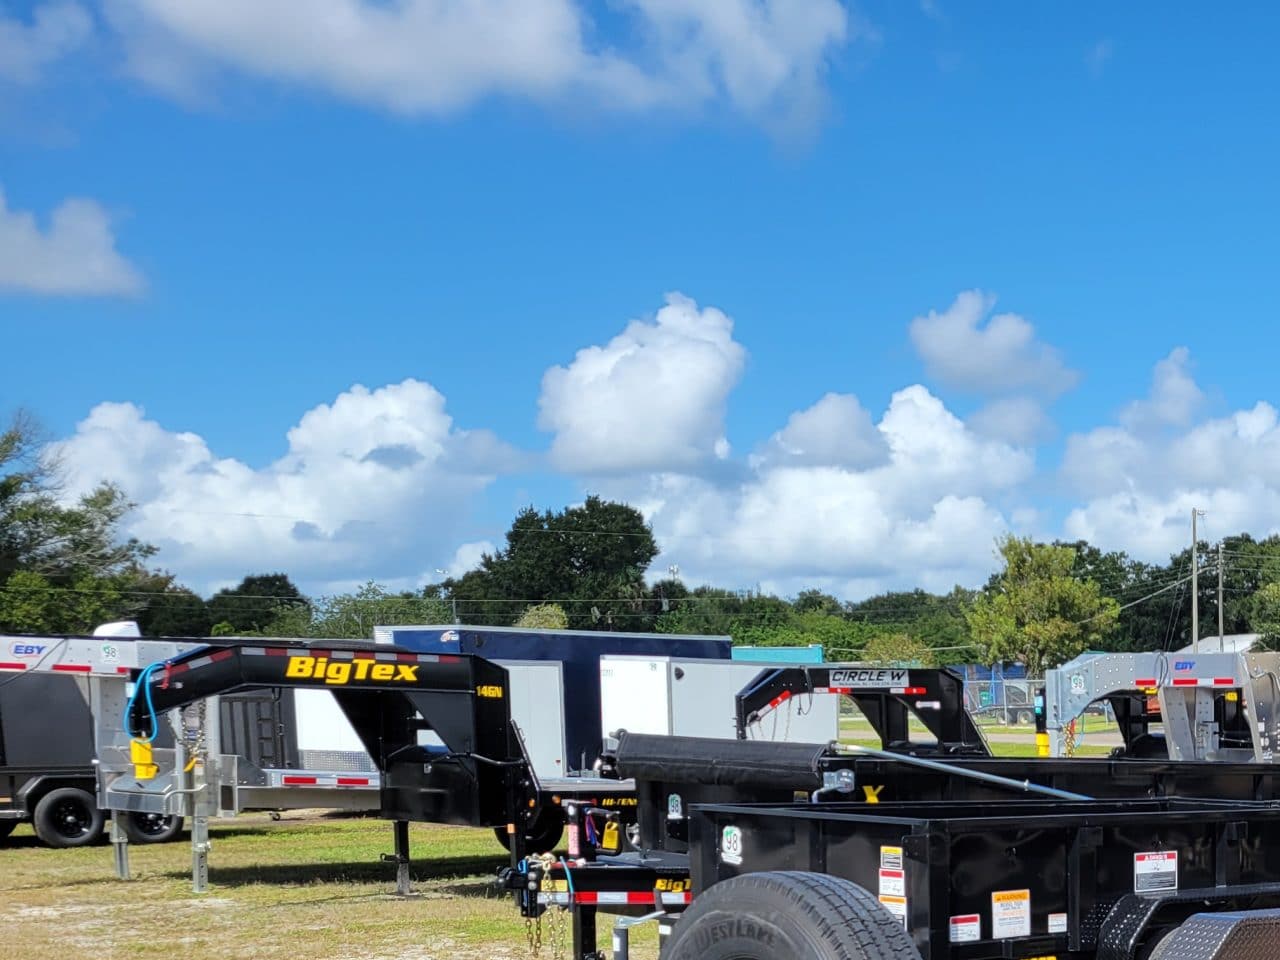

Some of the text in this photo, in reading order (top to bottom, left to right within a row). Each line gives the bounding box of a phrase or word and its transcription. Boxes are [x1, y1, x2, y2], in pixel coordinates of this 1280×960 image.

[13, 644, 46, 655] EBY
[104, 646, 117, 658] 98
[286, 656, 420, 684] BigTex
[832, 670, 906, 682] CIRCLE W
[670, 800, 680, 813] 98
[725, 833, 738, 852] 98
